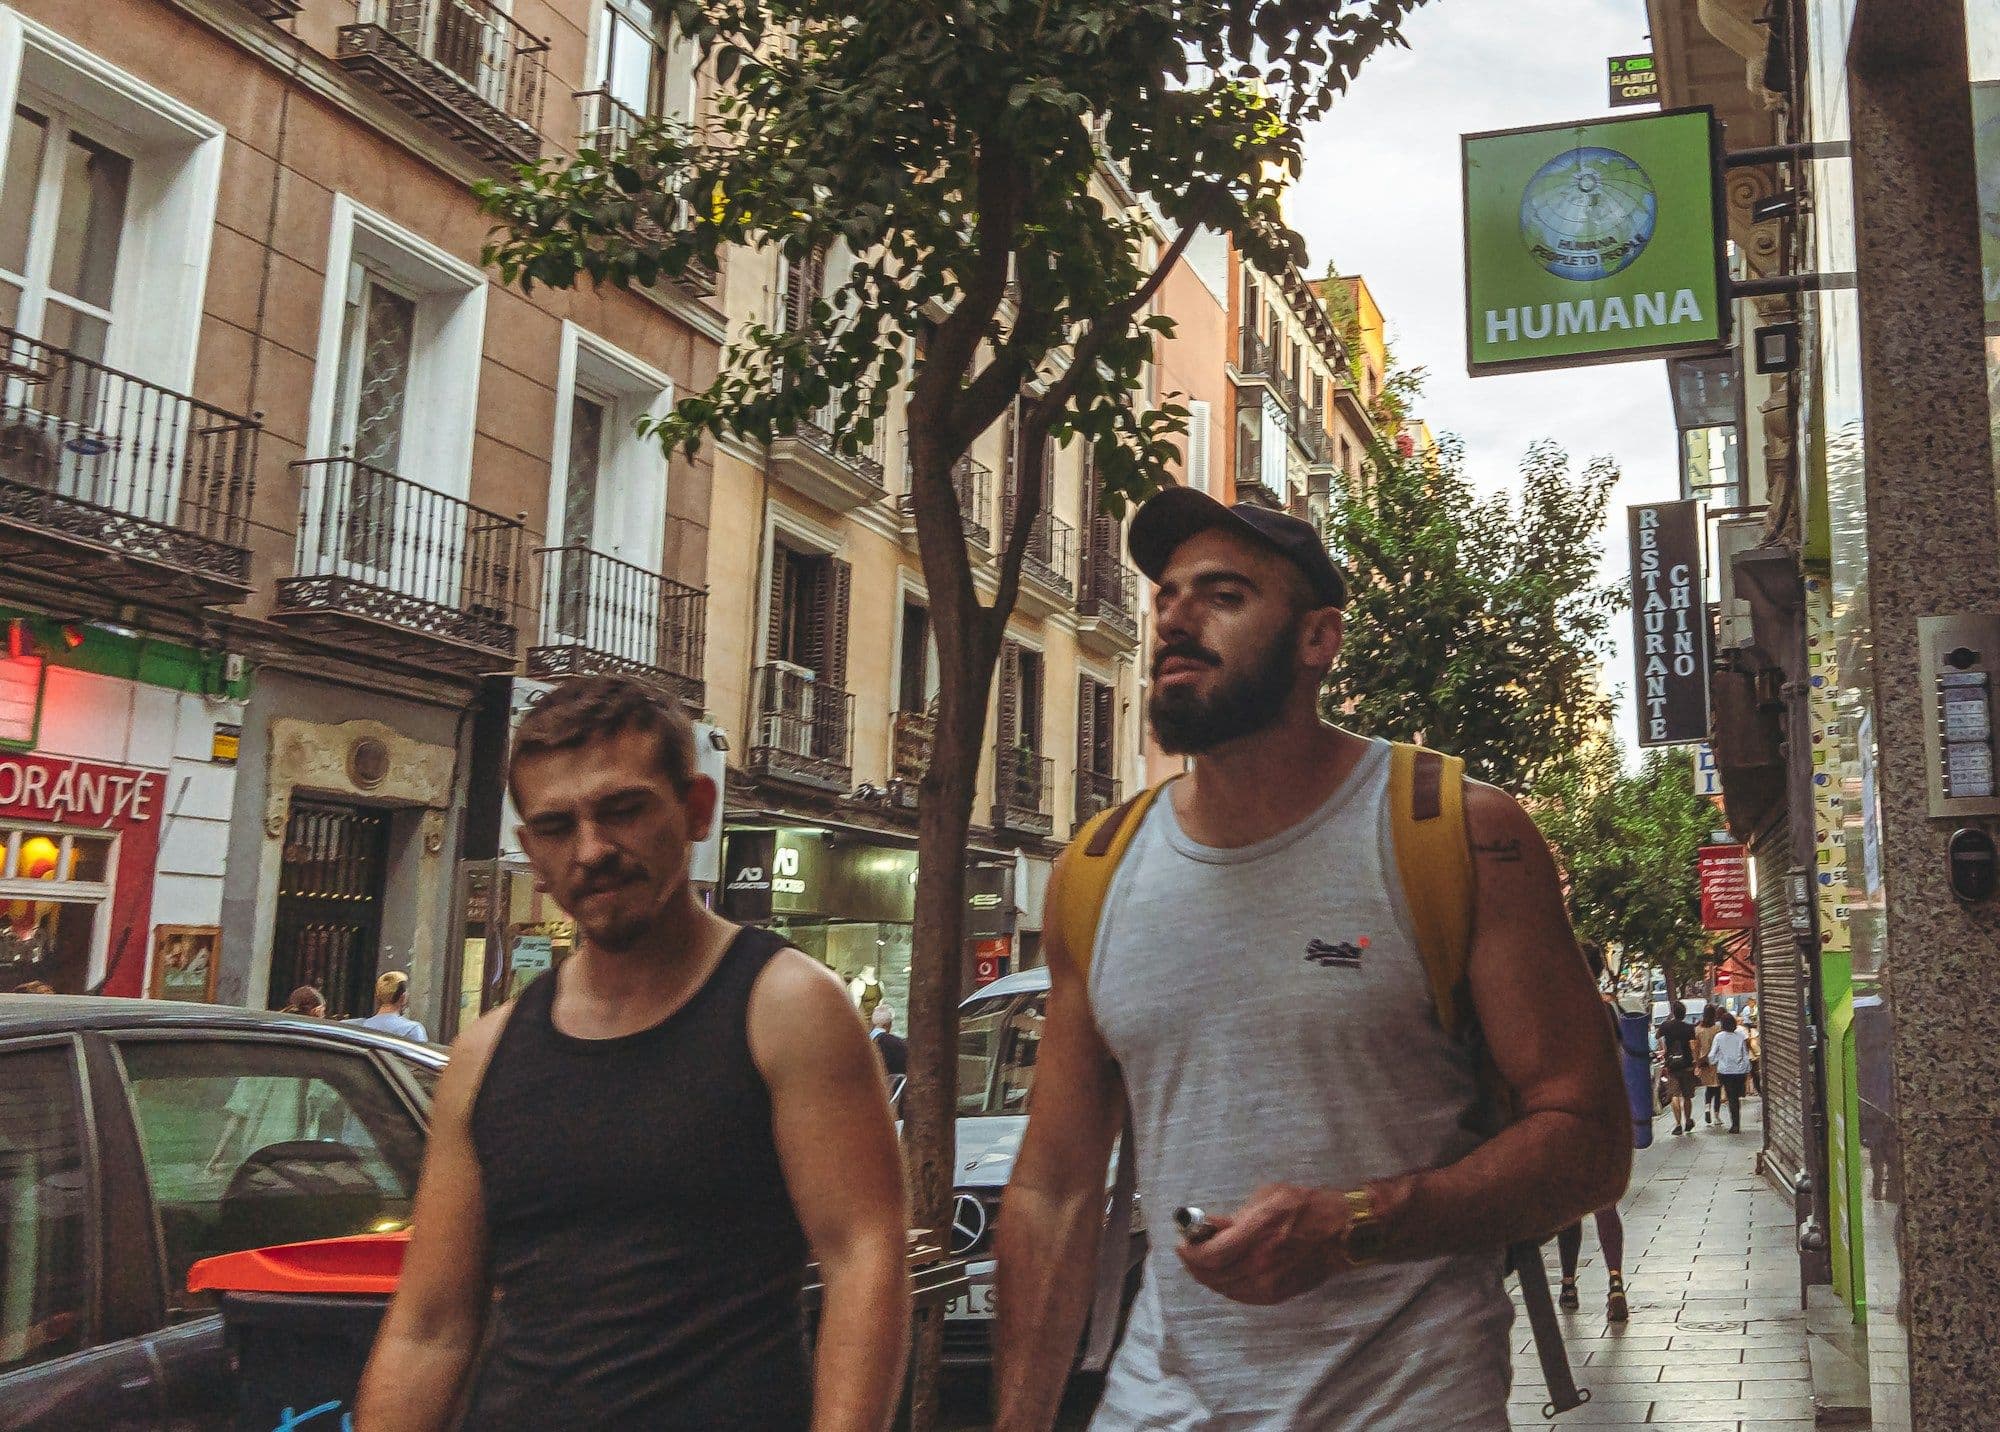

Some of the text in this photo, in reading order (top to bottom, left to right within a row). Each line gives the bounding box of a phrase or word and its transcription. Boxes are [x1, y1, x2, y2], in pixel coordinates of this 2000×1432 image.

[1485, 288, 1703, 343] HUMANA
[1638, 508, 1669, 739] RESTAURANTE
[1669, 564, 1696, 677] CHINO
[0, 761, 154, 822] ORANTE
